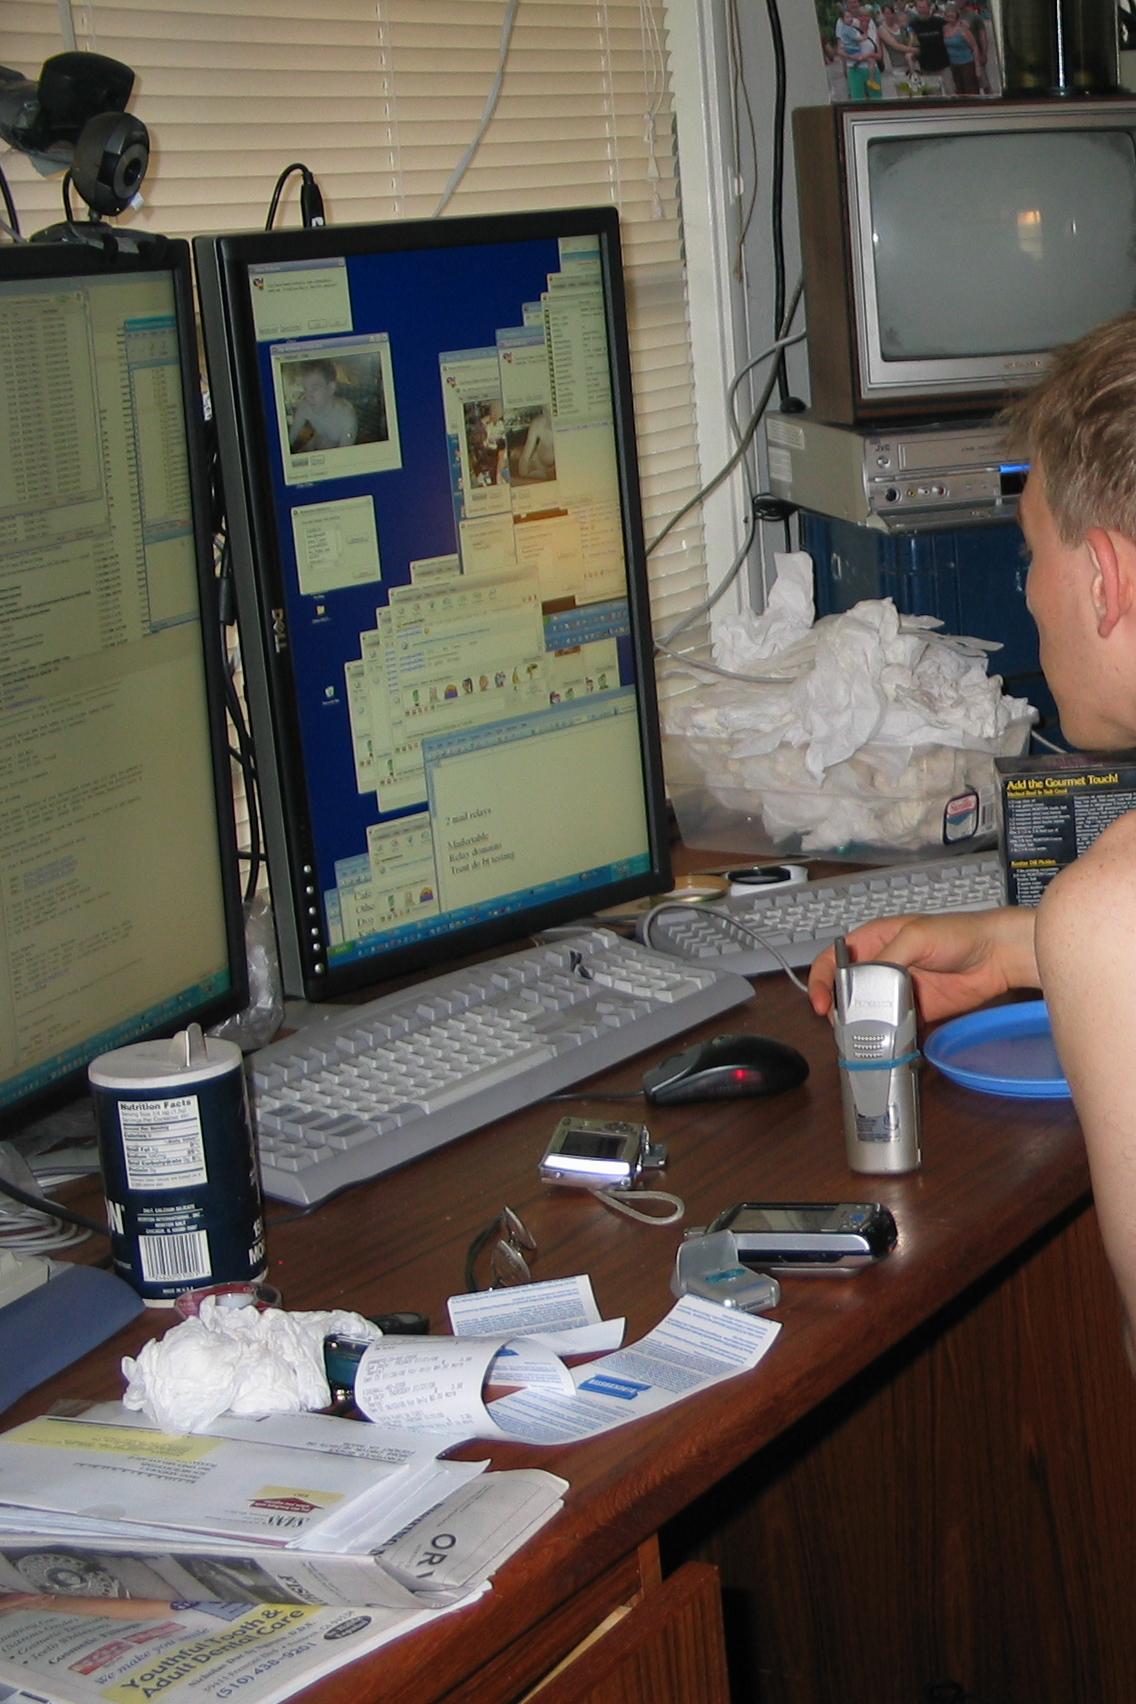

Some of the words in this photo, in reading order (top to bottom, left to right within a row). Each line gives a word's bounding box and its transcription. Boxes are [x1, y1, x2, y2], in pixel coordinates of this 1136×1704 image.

[1007, 779, 1027, 791] Add
[1028, 779, 1044, 790] the
[1045, 776, 1087, 788] Gourmet
[1087, 773, 1119, 785] Touch!
[120, 1102, 161, 1111] Nutrition
[164, 1099, 192, 1109] Facts
[118, 1651, 151, 1674] make
[156, 1638, 177, 1655] you
[121, 1639, 205, 1690] Youthful
[205, 1619, 264, 1652] Tooth
[260, 1606, 283, 1621] &
[140, 1659, 197, 1699] Adult
[192, 1631, 251, 1665] Dental
[255, 1609, 306, 1642] Care
[215, 1672, 256, 1700] (510)
